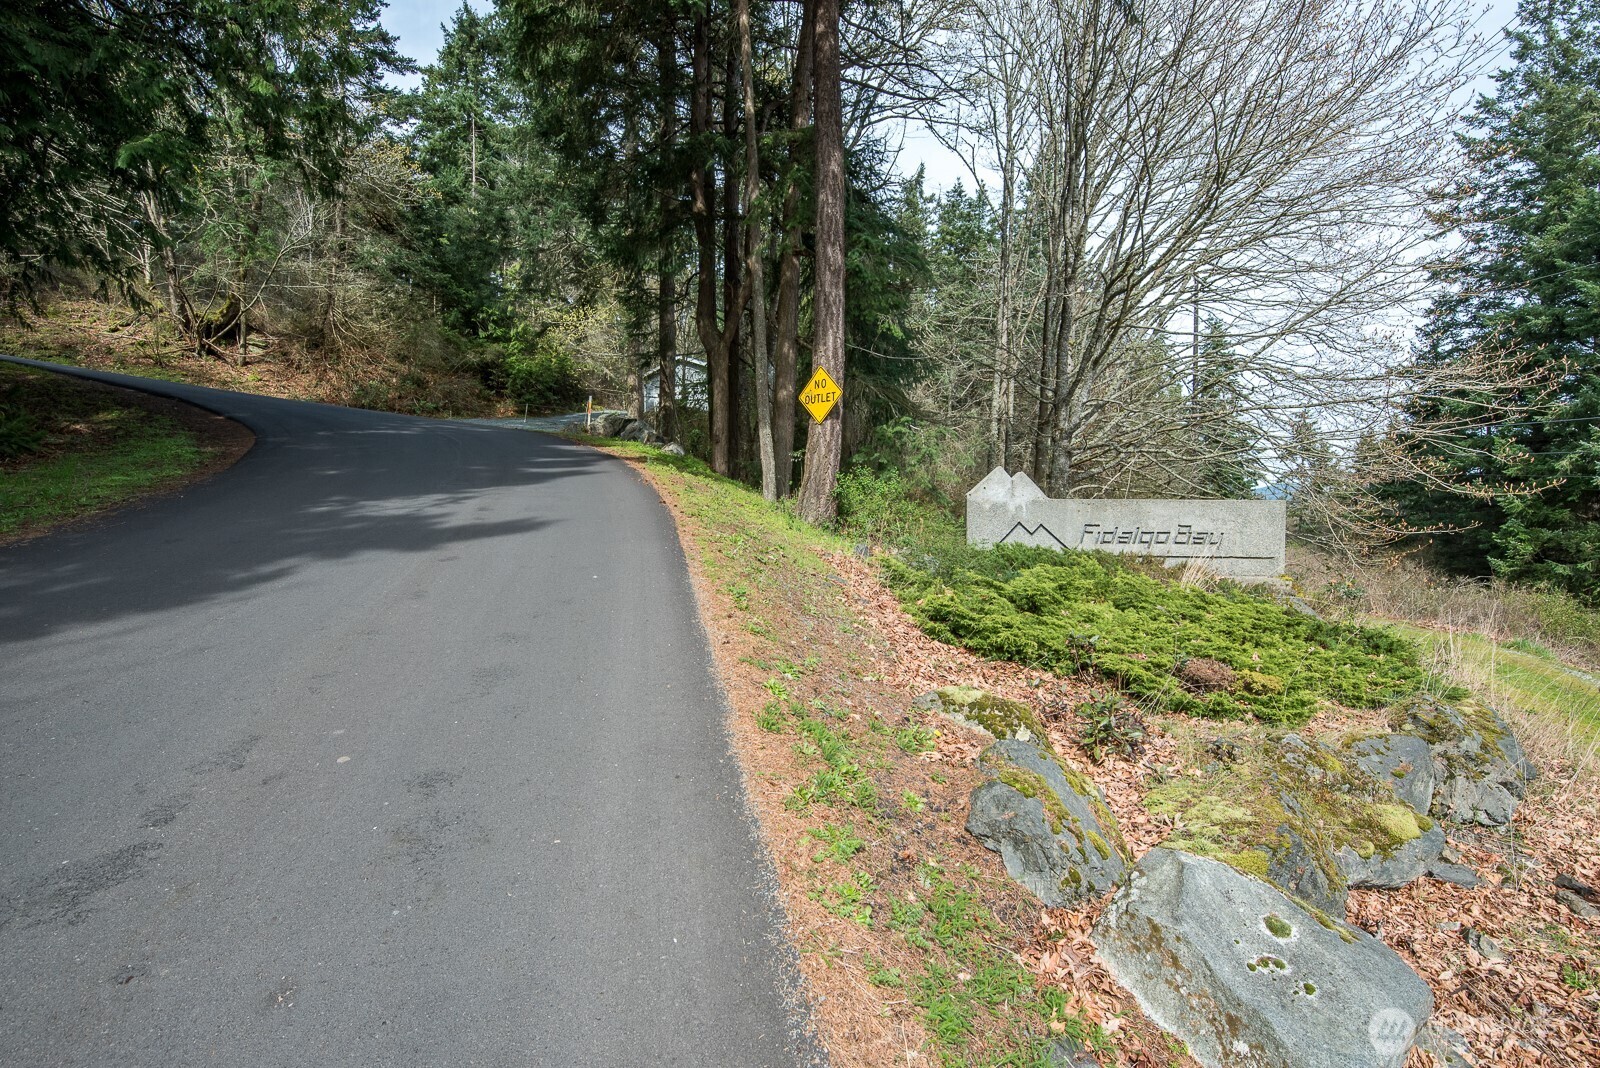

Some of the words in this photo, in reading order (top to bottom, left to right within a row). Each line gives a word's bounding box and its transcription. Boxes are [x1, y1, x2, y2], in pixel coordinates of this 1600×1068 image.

[814, 378, 827, 389] NO
[804, 391, 836, 405] OUTLET
[1080, 523, 1171, 549] Fidalgo
[1173, 524, 1225, 550] Bay
